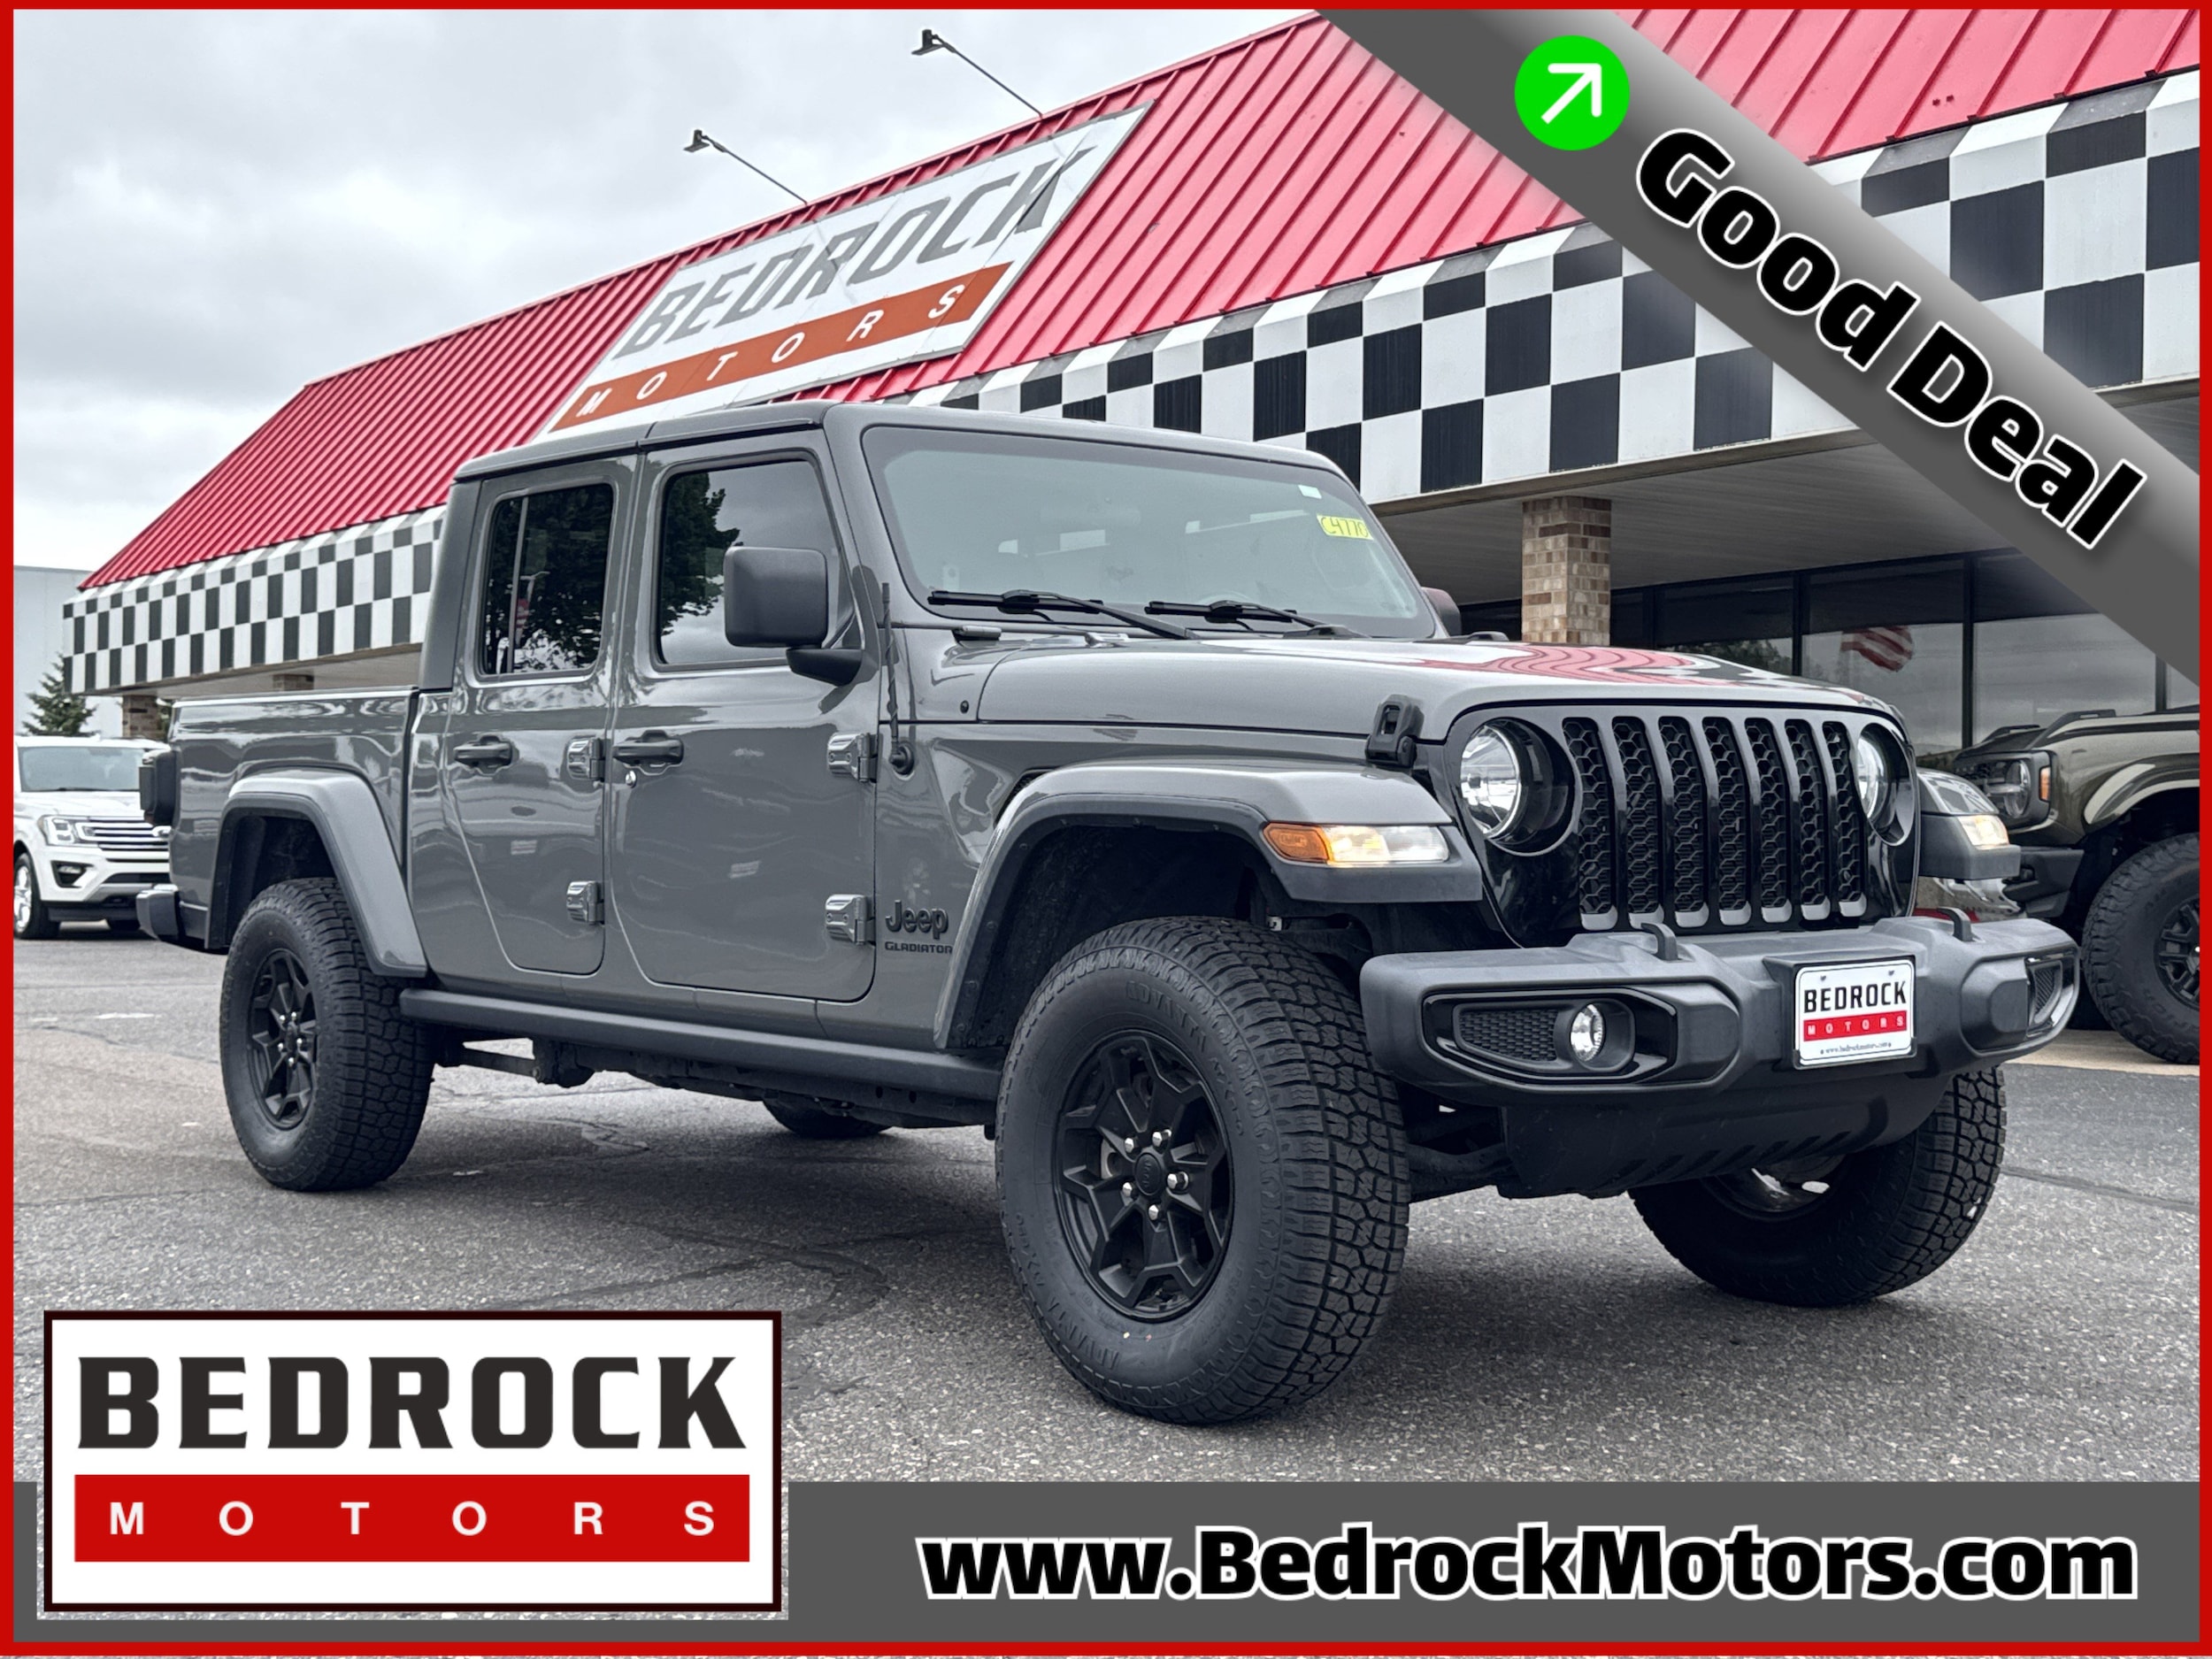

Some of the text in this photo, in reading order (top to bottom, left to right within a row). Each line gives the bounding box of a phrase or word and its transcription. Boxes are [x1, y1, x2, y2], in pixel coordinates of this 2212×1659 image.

[613, 145, 1097, 359] BEDROCK
[577, 283, 964, 417] MOTORS
[885, 899, 949, 940] Jeep
[885, 941, 953, 955] GLADIATOR
[1803, 980, 1907, 1013] BEDROCK
[1807, 1016, 1903, 1035] MOTORS
